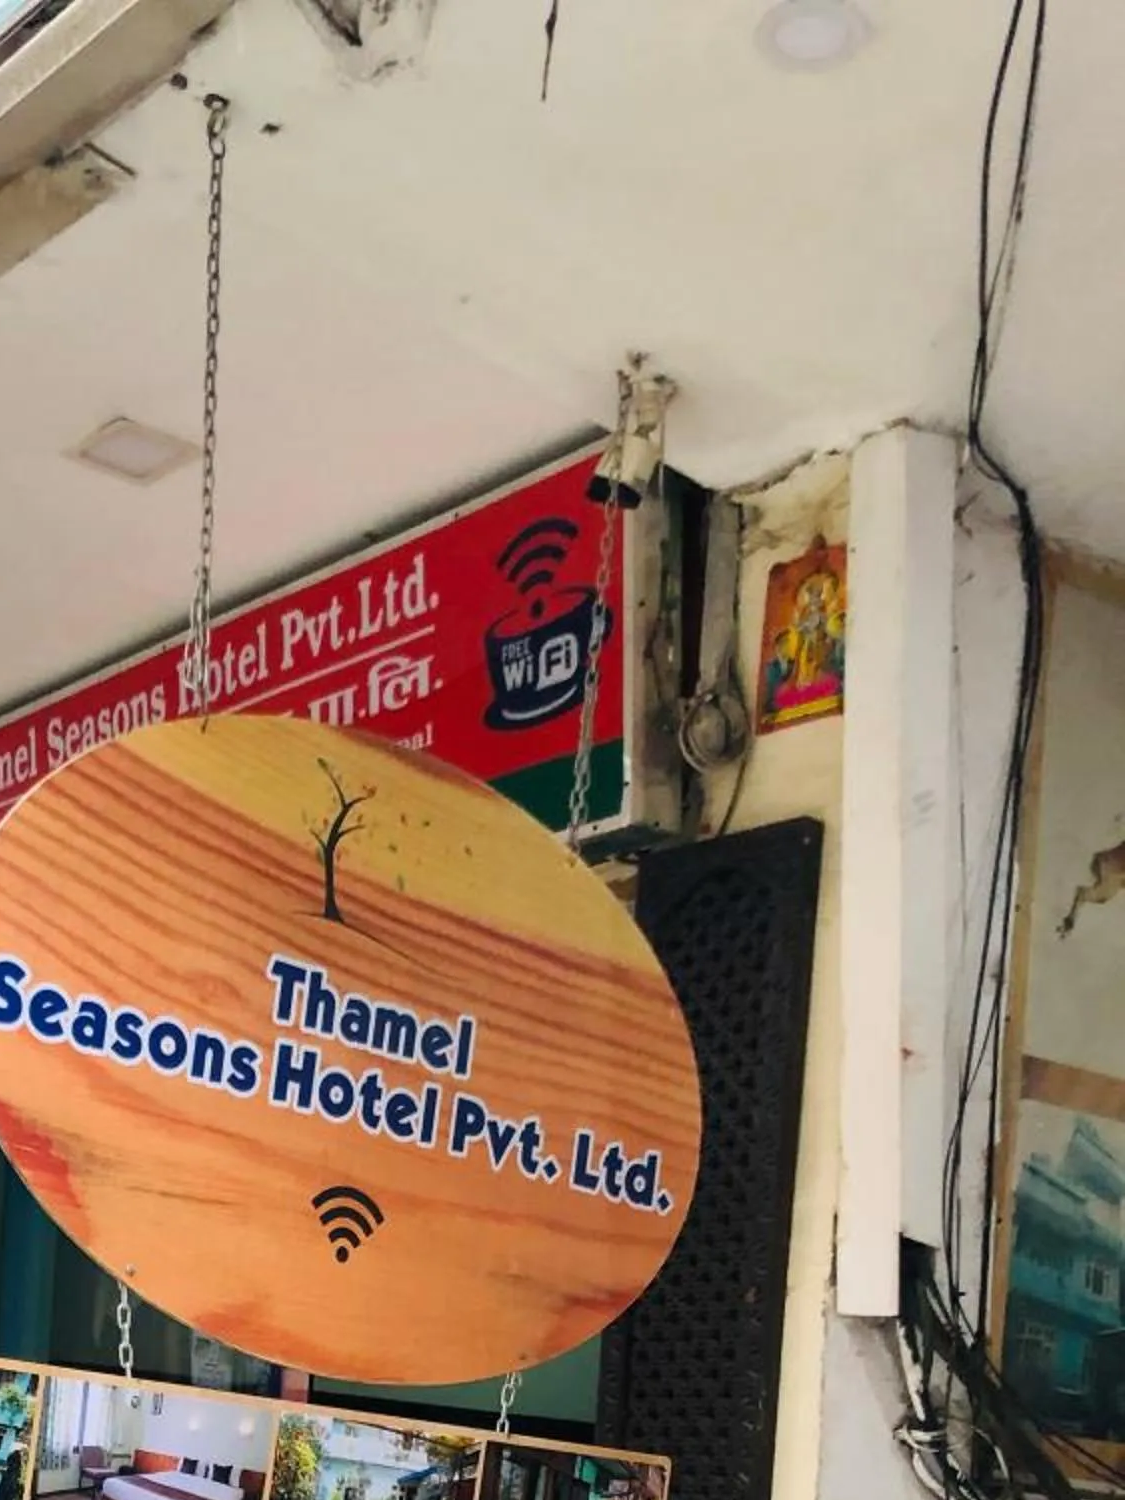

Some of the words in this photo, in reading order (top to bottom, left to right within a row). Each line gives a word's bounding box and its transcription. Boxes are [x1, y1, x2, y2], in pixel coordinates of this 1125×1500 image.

[46, 682, 166, 771] Seasons
[175, 620, 269, 716] Hotel
[270, 957, 475, 1076] Thamel
[270, 1041, 436, 1147] Hotel
[450, 1088, 561, 1184] Pvt.
[570, 1129, 674, 1214] Ltd.
